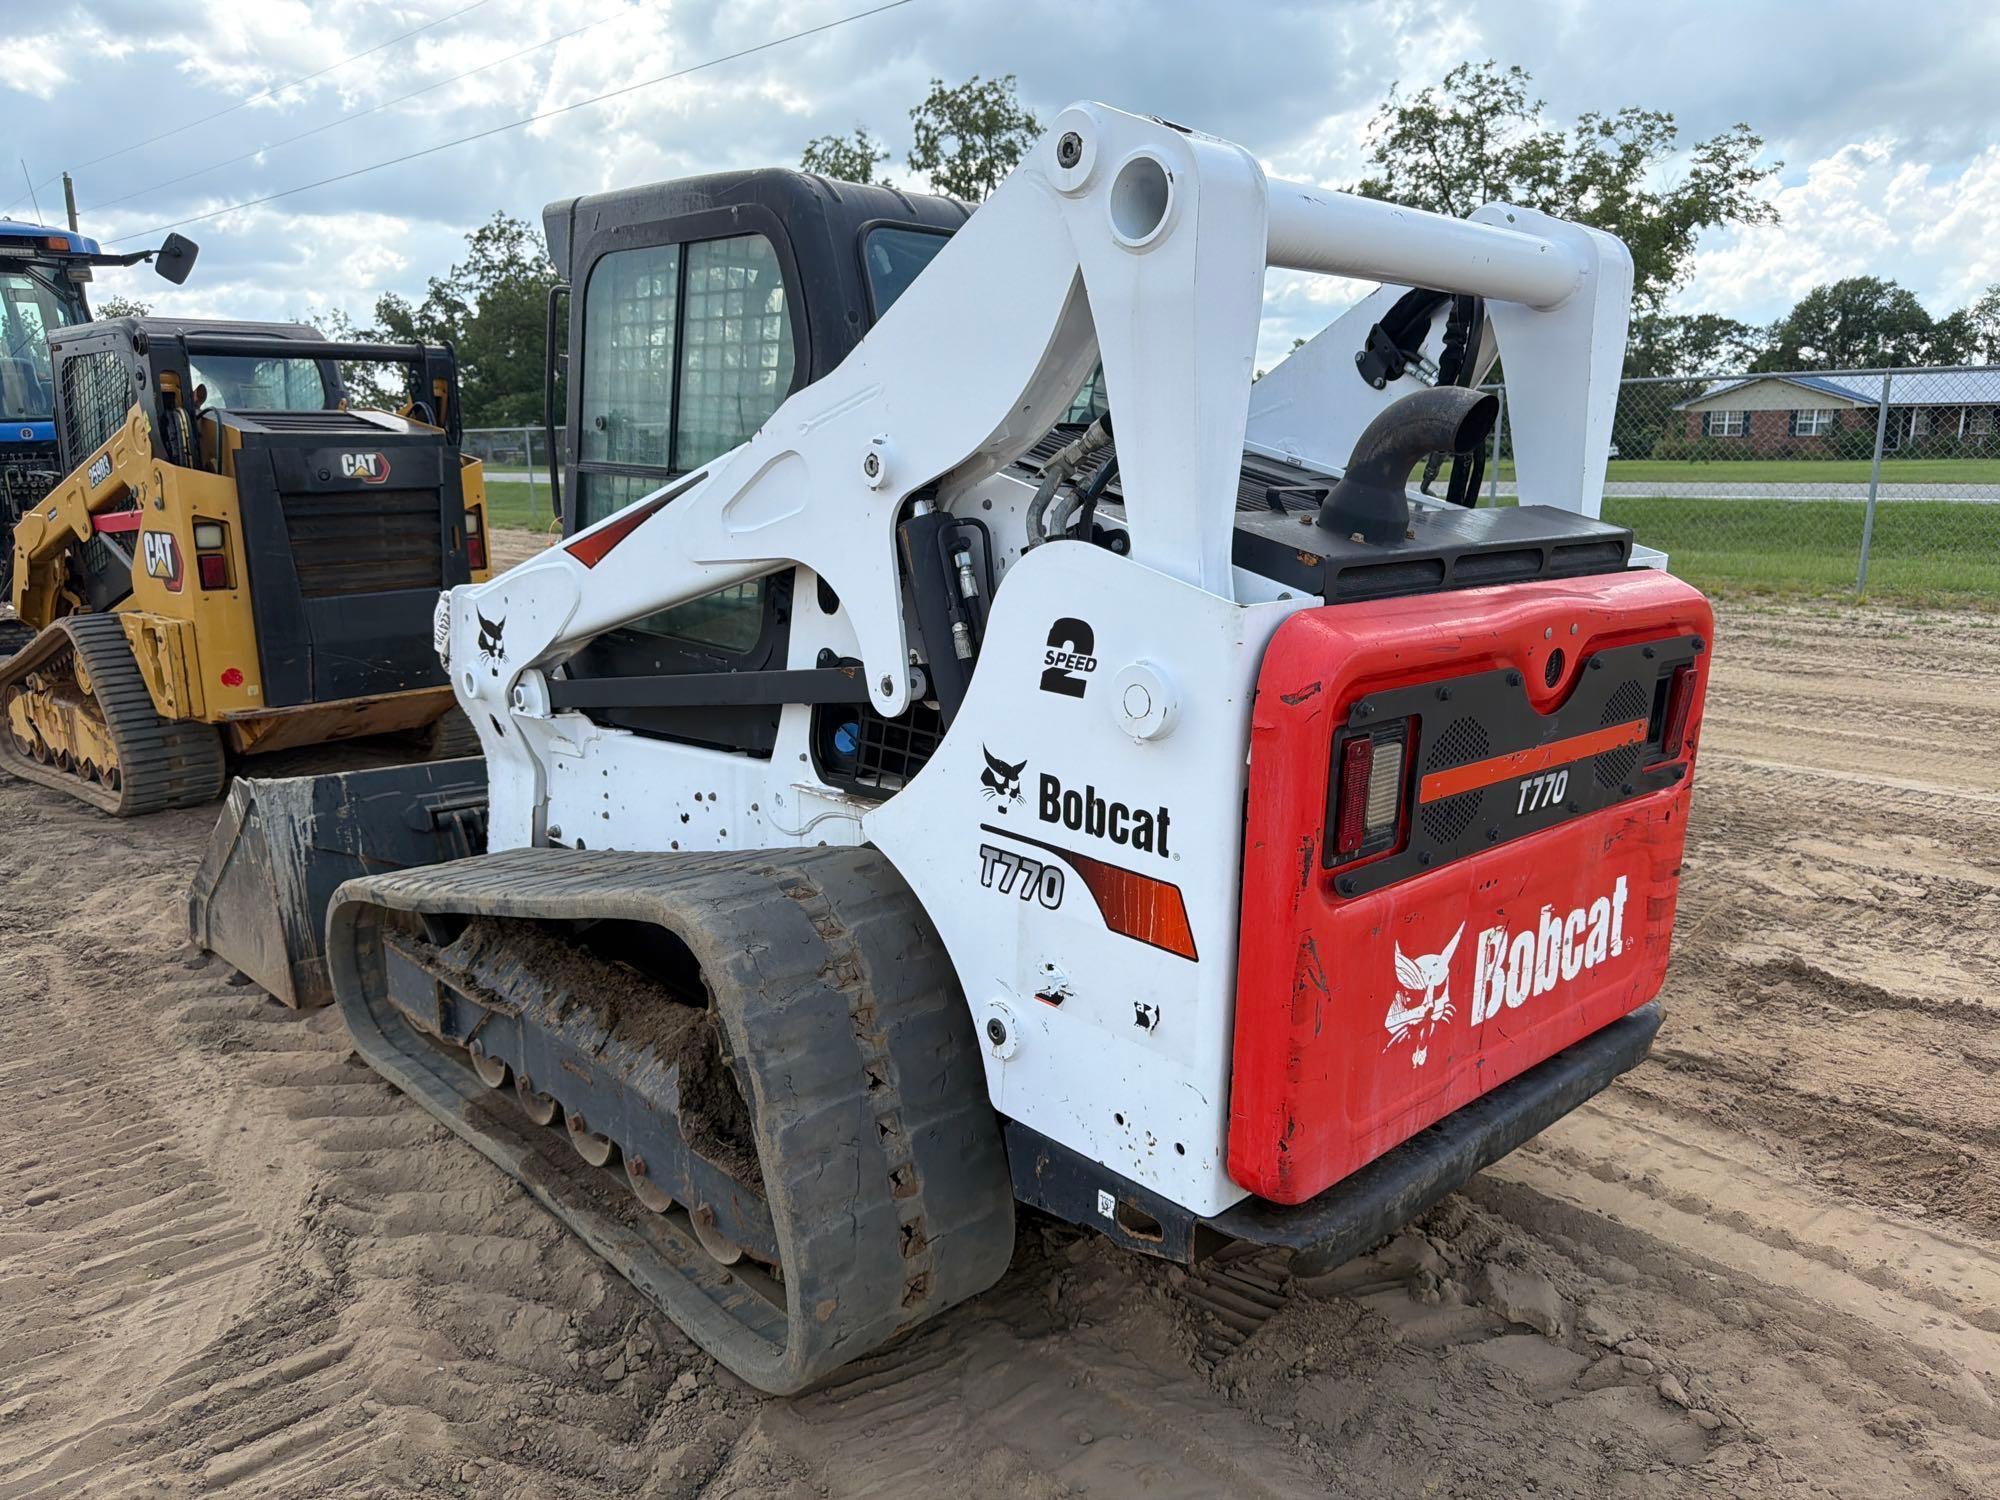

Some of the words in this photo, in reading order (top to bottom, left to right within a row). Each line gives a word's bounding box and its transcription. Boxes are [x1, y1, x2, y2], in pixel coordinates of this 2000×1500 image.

[341, 453, 376, 477] CAT
[143, 532, 174, 579] CAT
[1039, 617, 1095, 699] 2
[1044, 650, 1098, 673] SPEED
[1039, 772, 1170, 858] Bobcat
[1517, 769, 1569, 815] T770
[979, 843, 1065, 911] T770
[1471, 875, 1628, 1027] Bobcat
